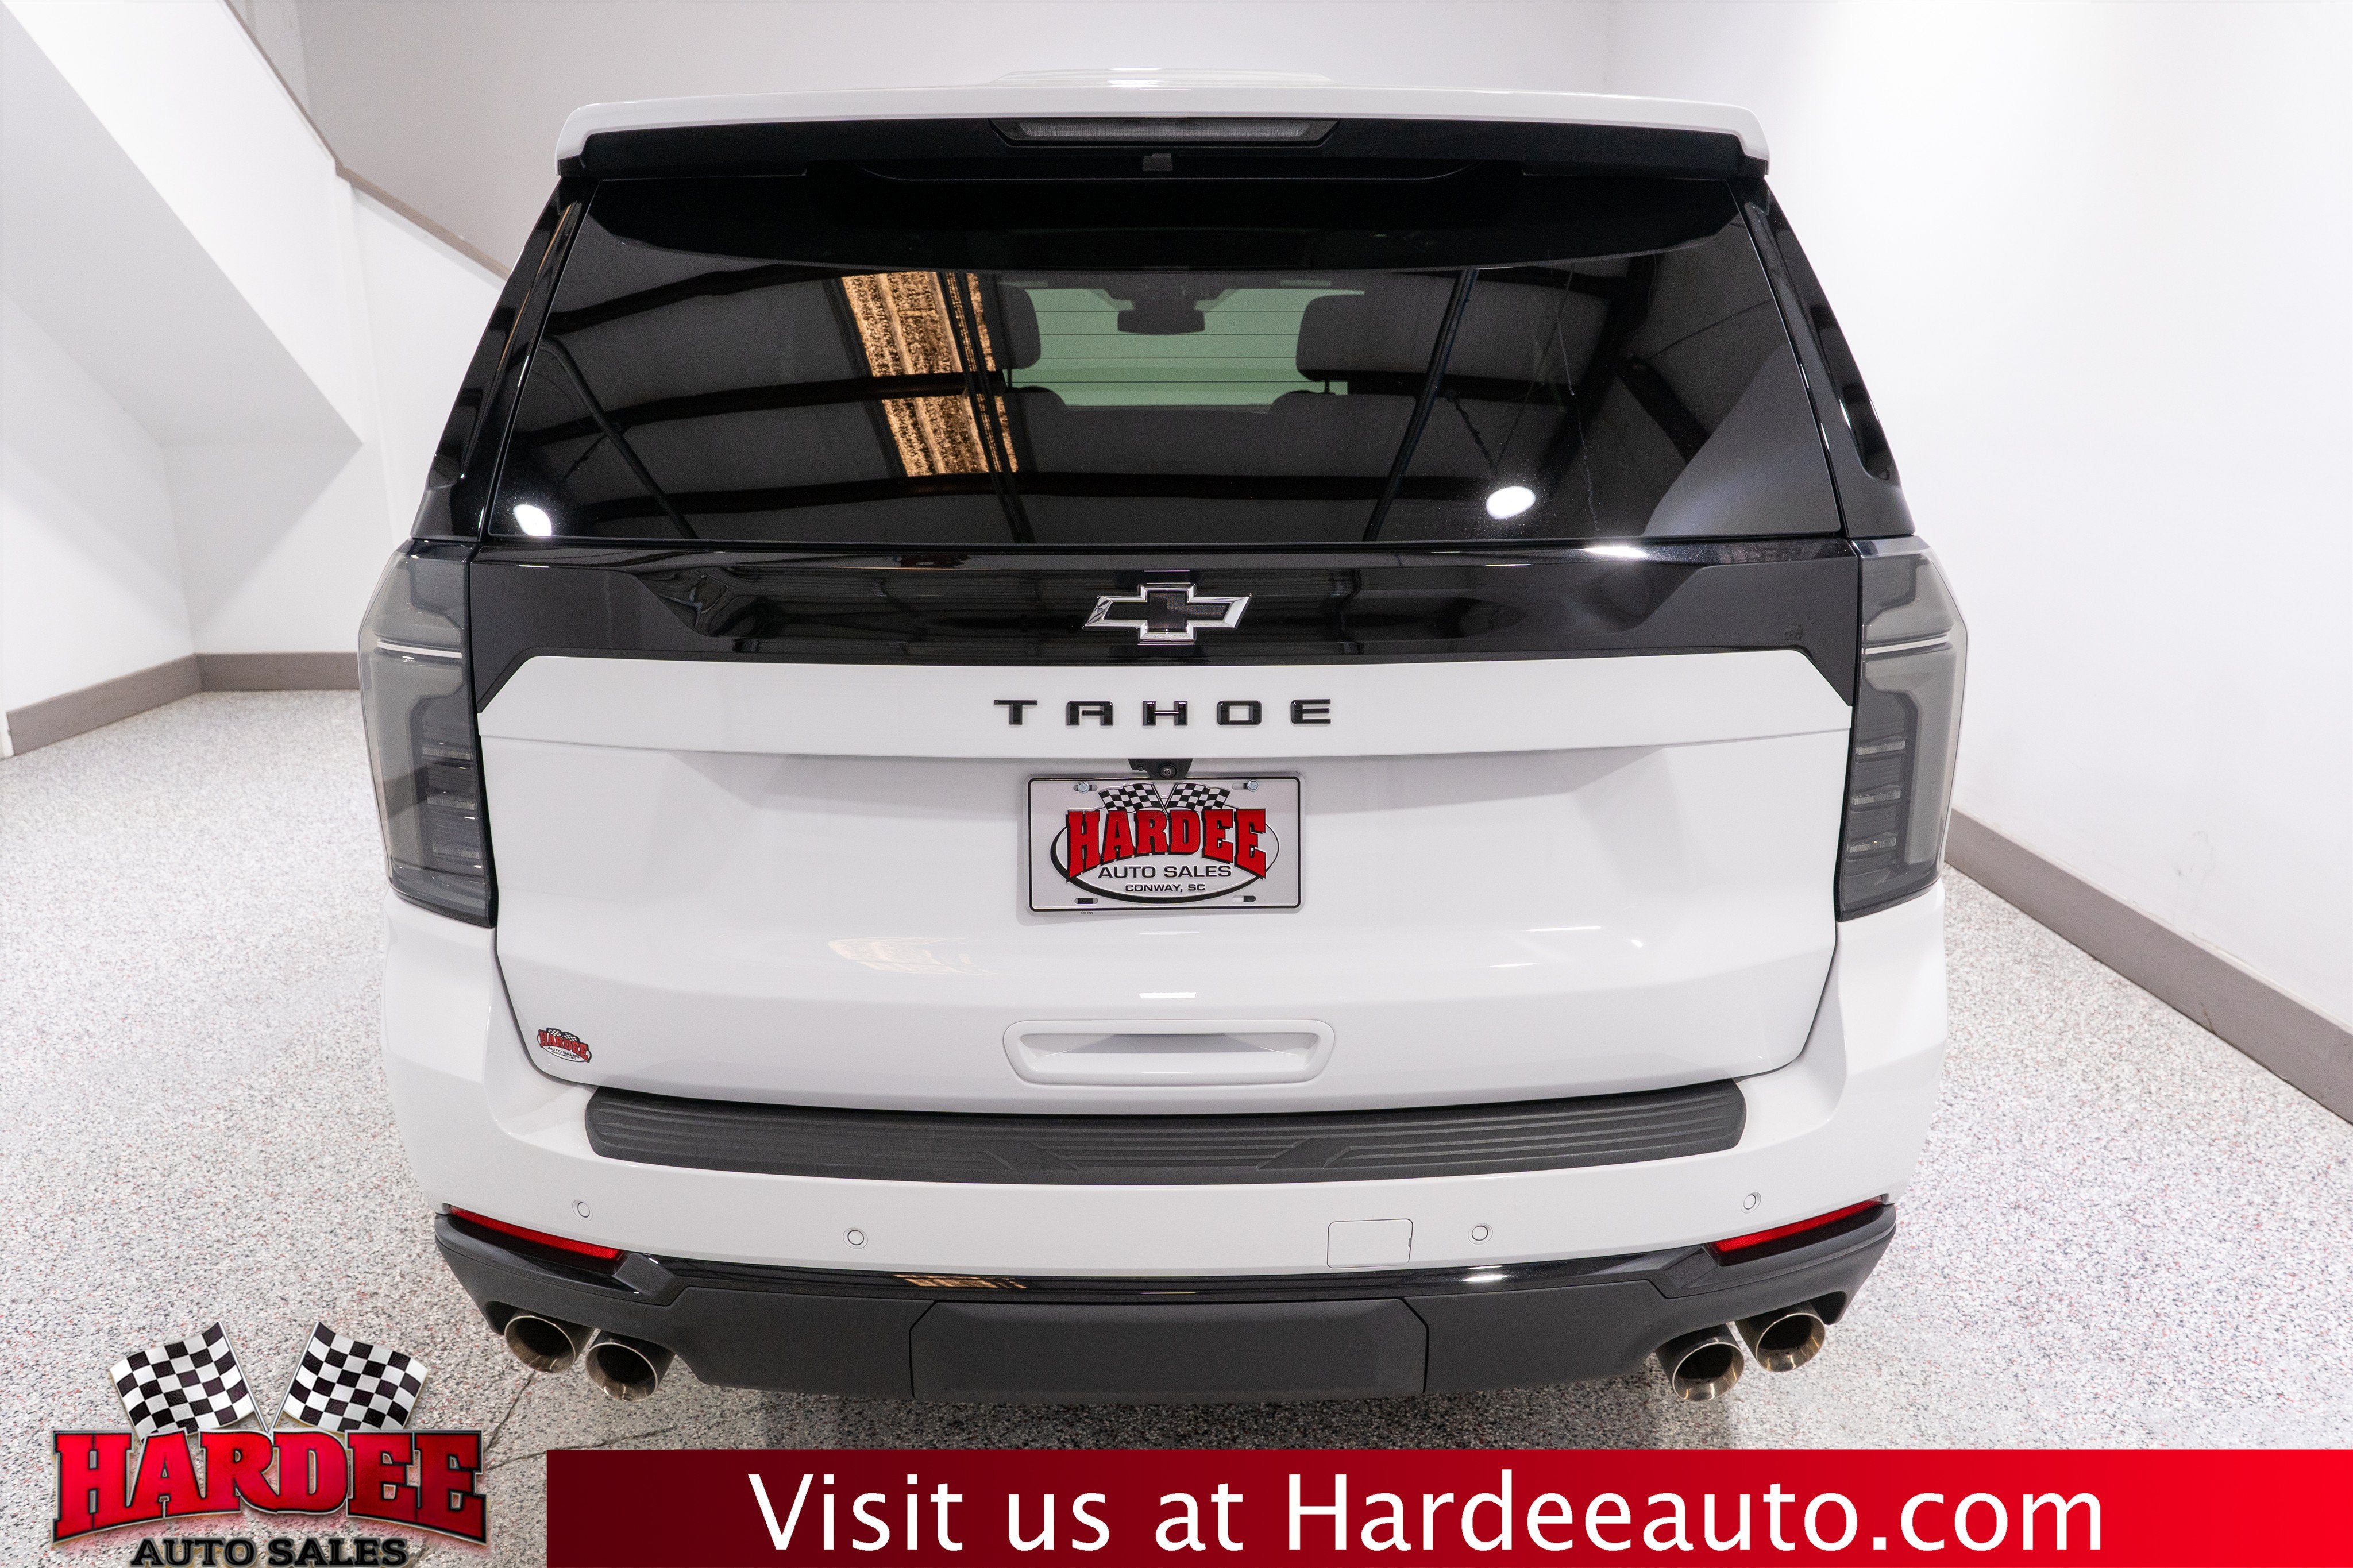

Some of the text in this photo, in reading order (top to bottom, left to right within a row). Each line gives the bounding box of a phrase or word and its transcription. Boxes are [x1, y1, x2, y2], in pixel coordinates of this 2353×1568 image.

[994, 698, 1332, 726] TAHOE
[1066, 808, 1266, 882] HARDEE
[1098, 866, 1232, 879] AUTO SALES
[1125, 883, 1206, 893] CONWAY, SC
[539, 1030, 589, 1062] HARDEE
